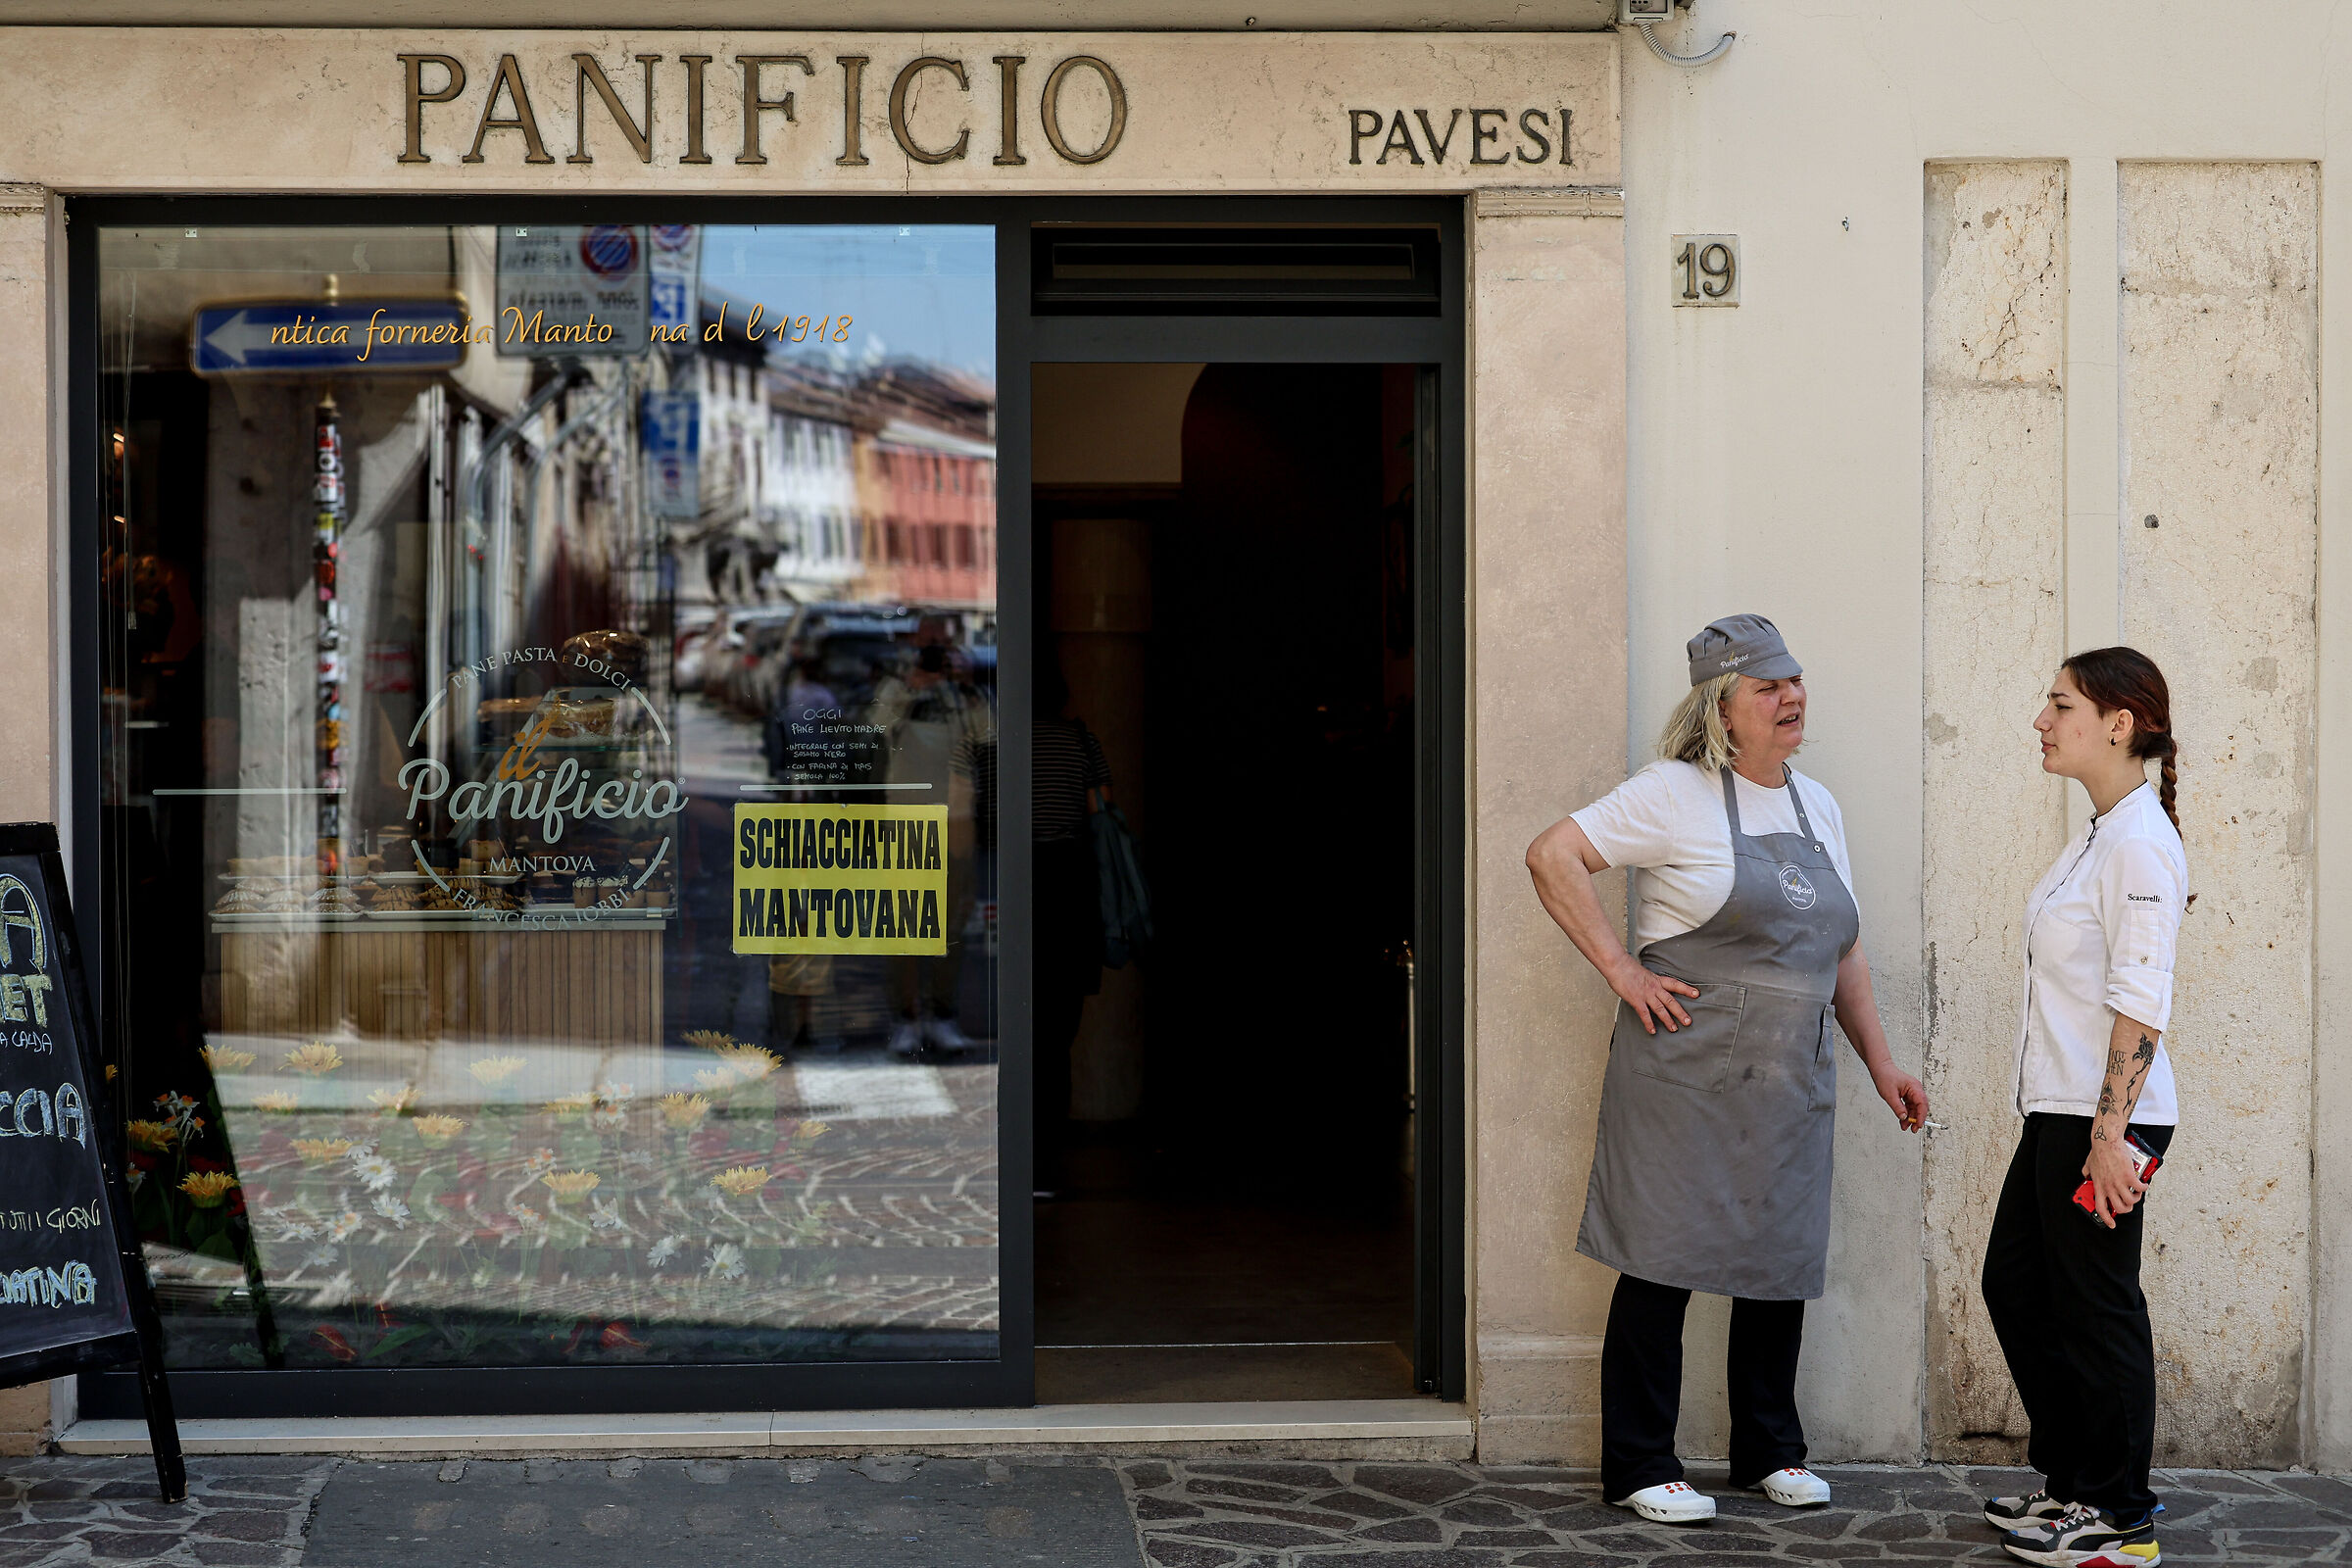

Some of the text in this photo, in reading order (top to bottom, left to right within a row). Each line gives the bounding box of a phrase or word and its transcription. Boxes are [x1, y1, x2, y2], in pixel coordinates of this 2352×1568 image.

[397, 54, 1127, 165] PANIFICIO
[1348, 108, 1574, 166] PAVESI
[1677, 242, 1736, 299] 19
[357, 308, 494, 362] forneria
[451, 656, 498, 689] PANE
[502, 648, 558, 665] PASTA
[574, 653, 632, 691] DOLCI
[498, 694, 563, 781] il
[791, 723, 814, 735] PANE
[854, 723, 887, 734] MADRE
[803, 709, 842, 721] OGGI
[397, 758, 689, 845] Panificio
[489, 856, 597, 873] MANTOVA
[740, 817, 942, 870] SCHIACCIATINA
[452, 888, 571, 931] FRANCESCA
[739, 888, 941, 939] MANTOVANA
